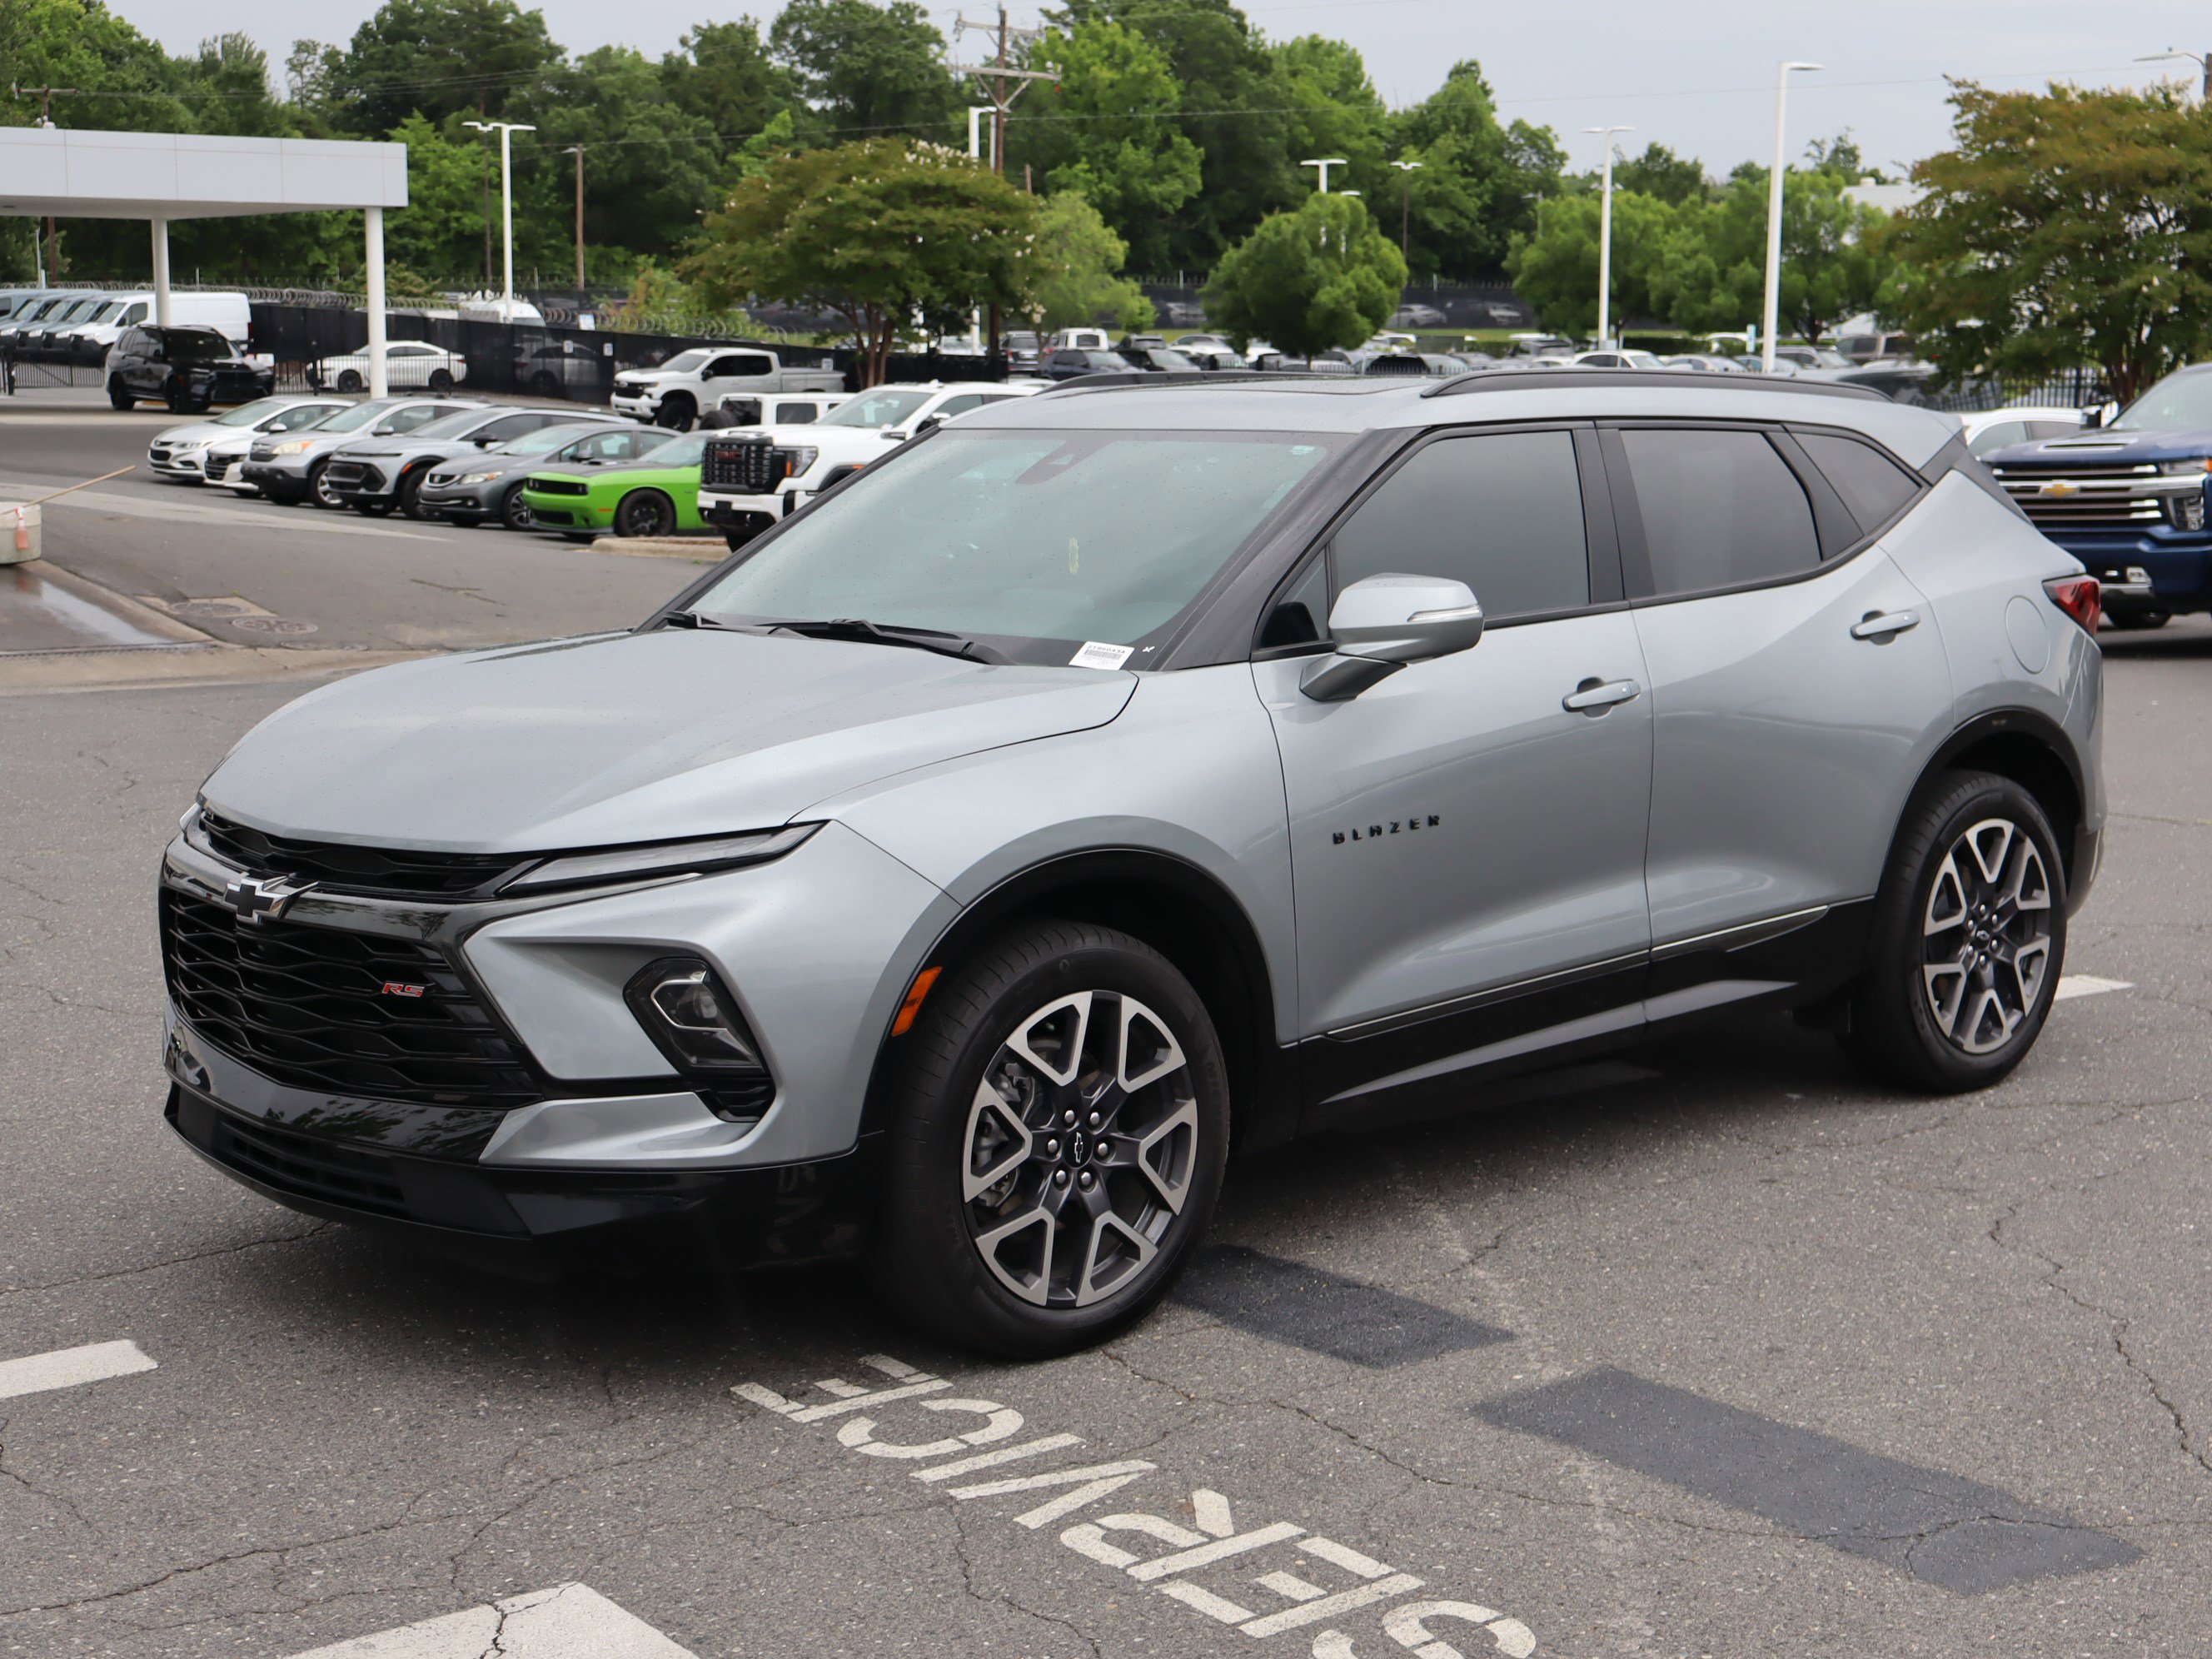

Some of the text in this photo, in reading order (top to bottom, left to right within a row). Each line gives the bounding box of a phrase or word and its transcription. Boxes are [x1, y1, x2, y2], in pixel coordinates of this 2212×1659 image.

[1332, 815, 1440, 844] BLAZER
[381, 982, 425, 998] RS
[730, 1353, 1536, 1659] SERVICE
